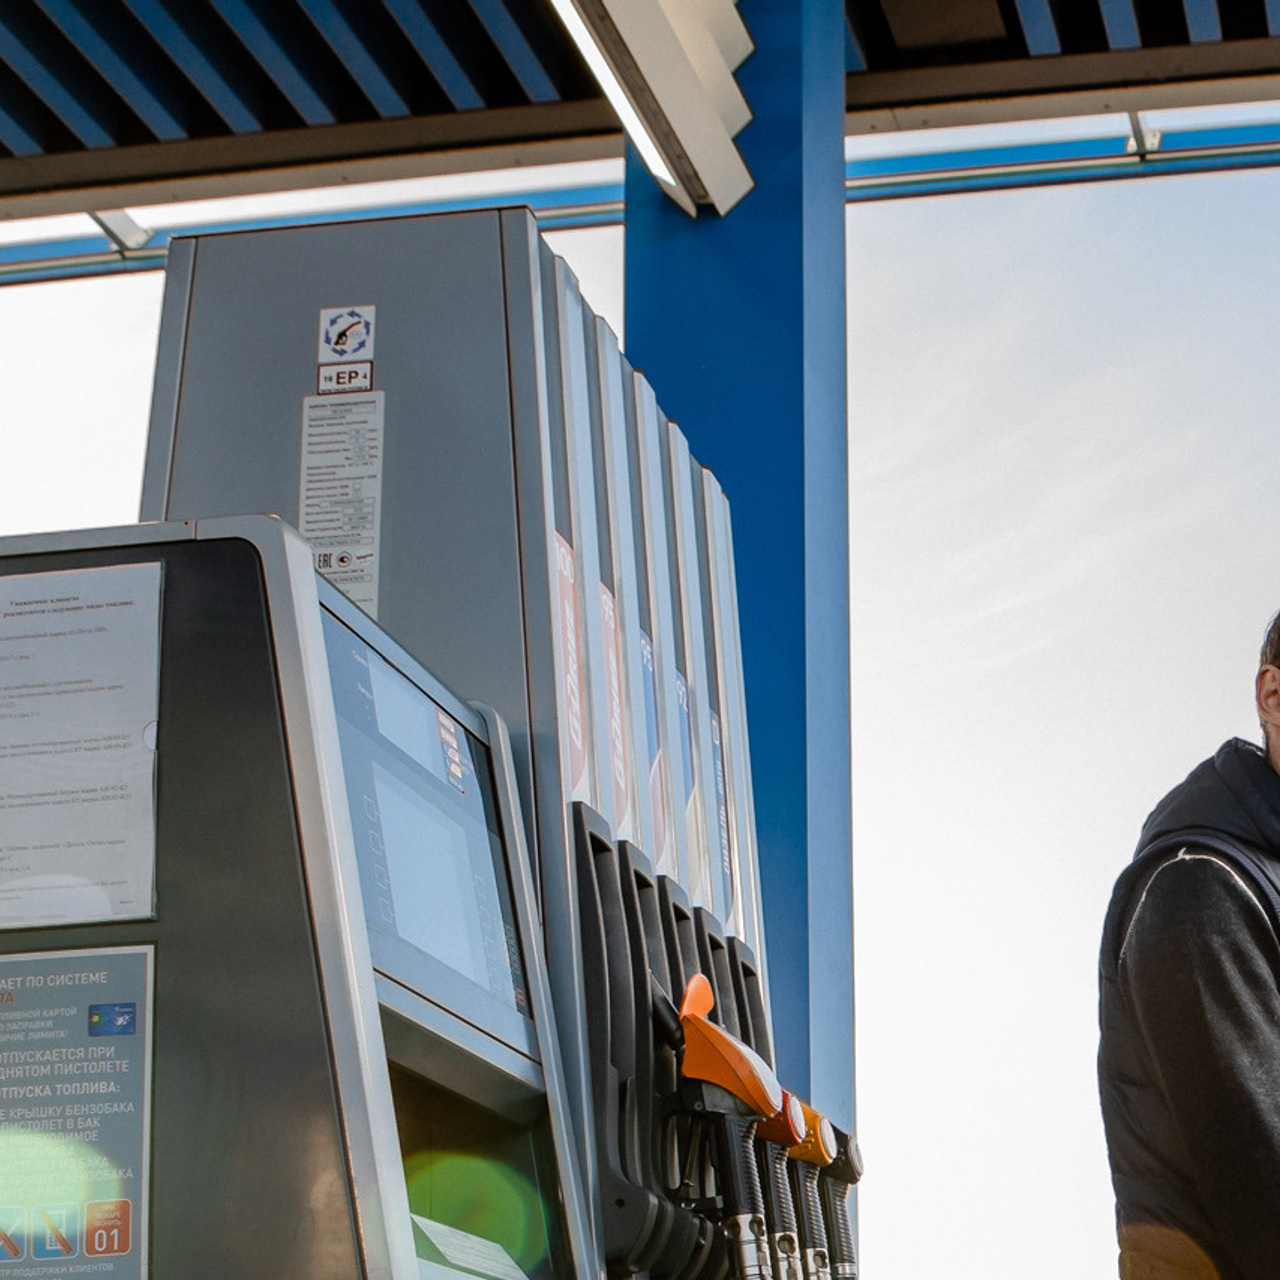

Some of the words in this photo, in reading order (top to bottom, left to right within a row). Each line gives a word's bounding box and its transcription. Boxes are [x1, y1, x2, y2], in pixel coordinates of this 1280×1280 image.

[26, 975, 43, 987] ПО
[47, 972, 108, 987] СИСТЕМЕ
[88, 1046, 115, 1058] ПРИ
[54, 1060, 129, 1075] ПИСТОЛЕТЕ
[55, 1081, 120, 1095] ТОПЛИВА:
[9, 1105, 63, 1119] КРЫШКУ
[66, 1102, 134, 1116] БЕНЗОБАКА
[67, 1118, 74, 1129] В
[78, 1117, 100, 1129] БАК
[95, 1228, 119, 1252] 01
